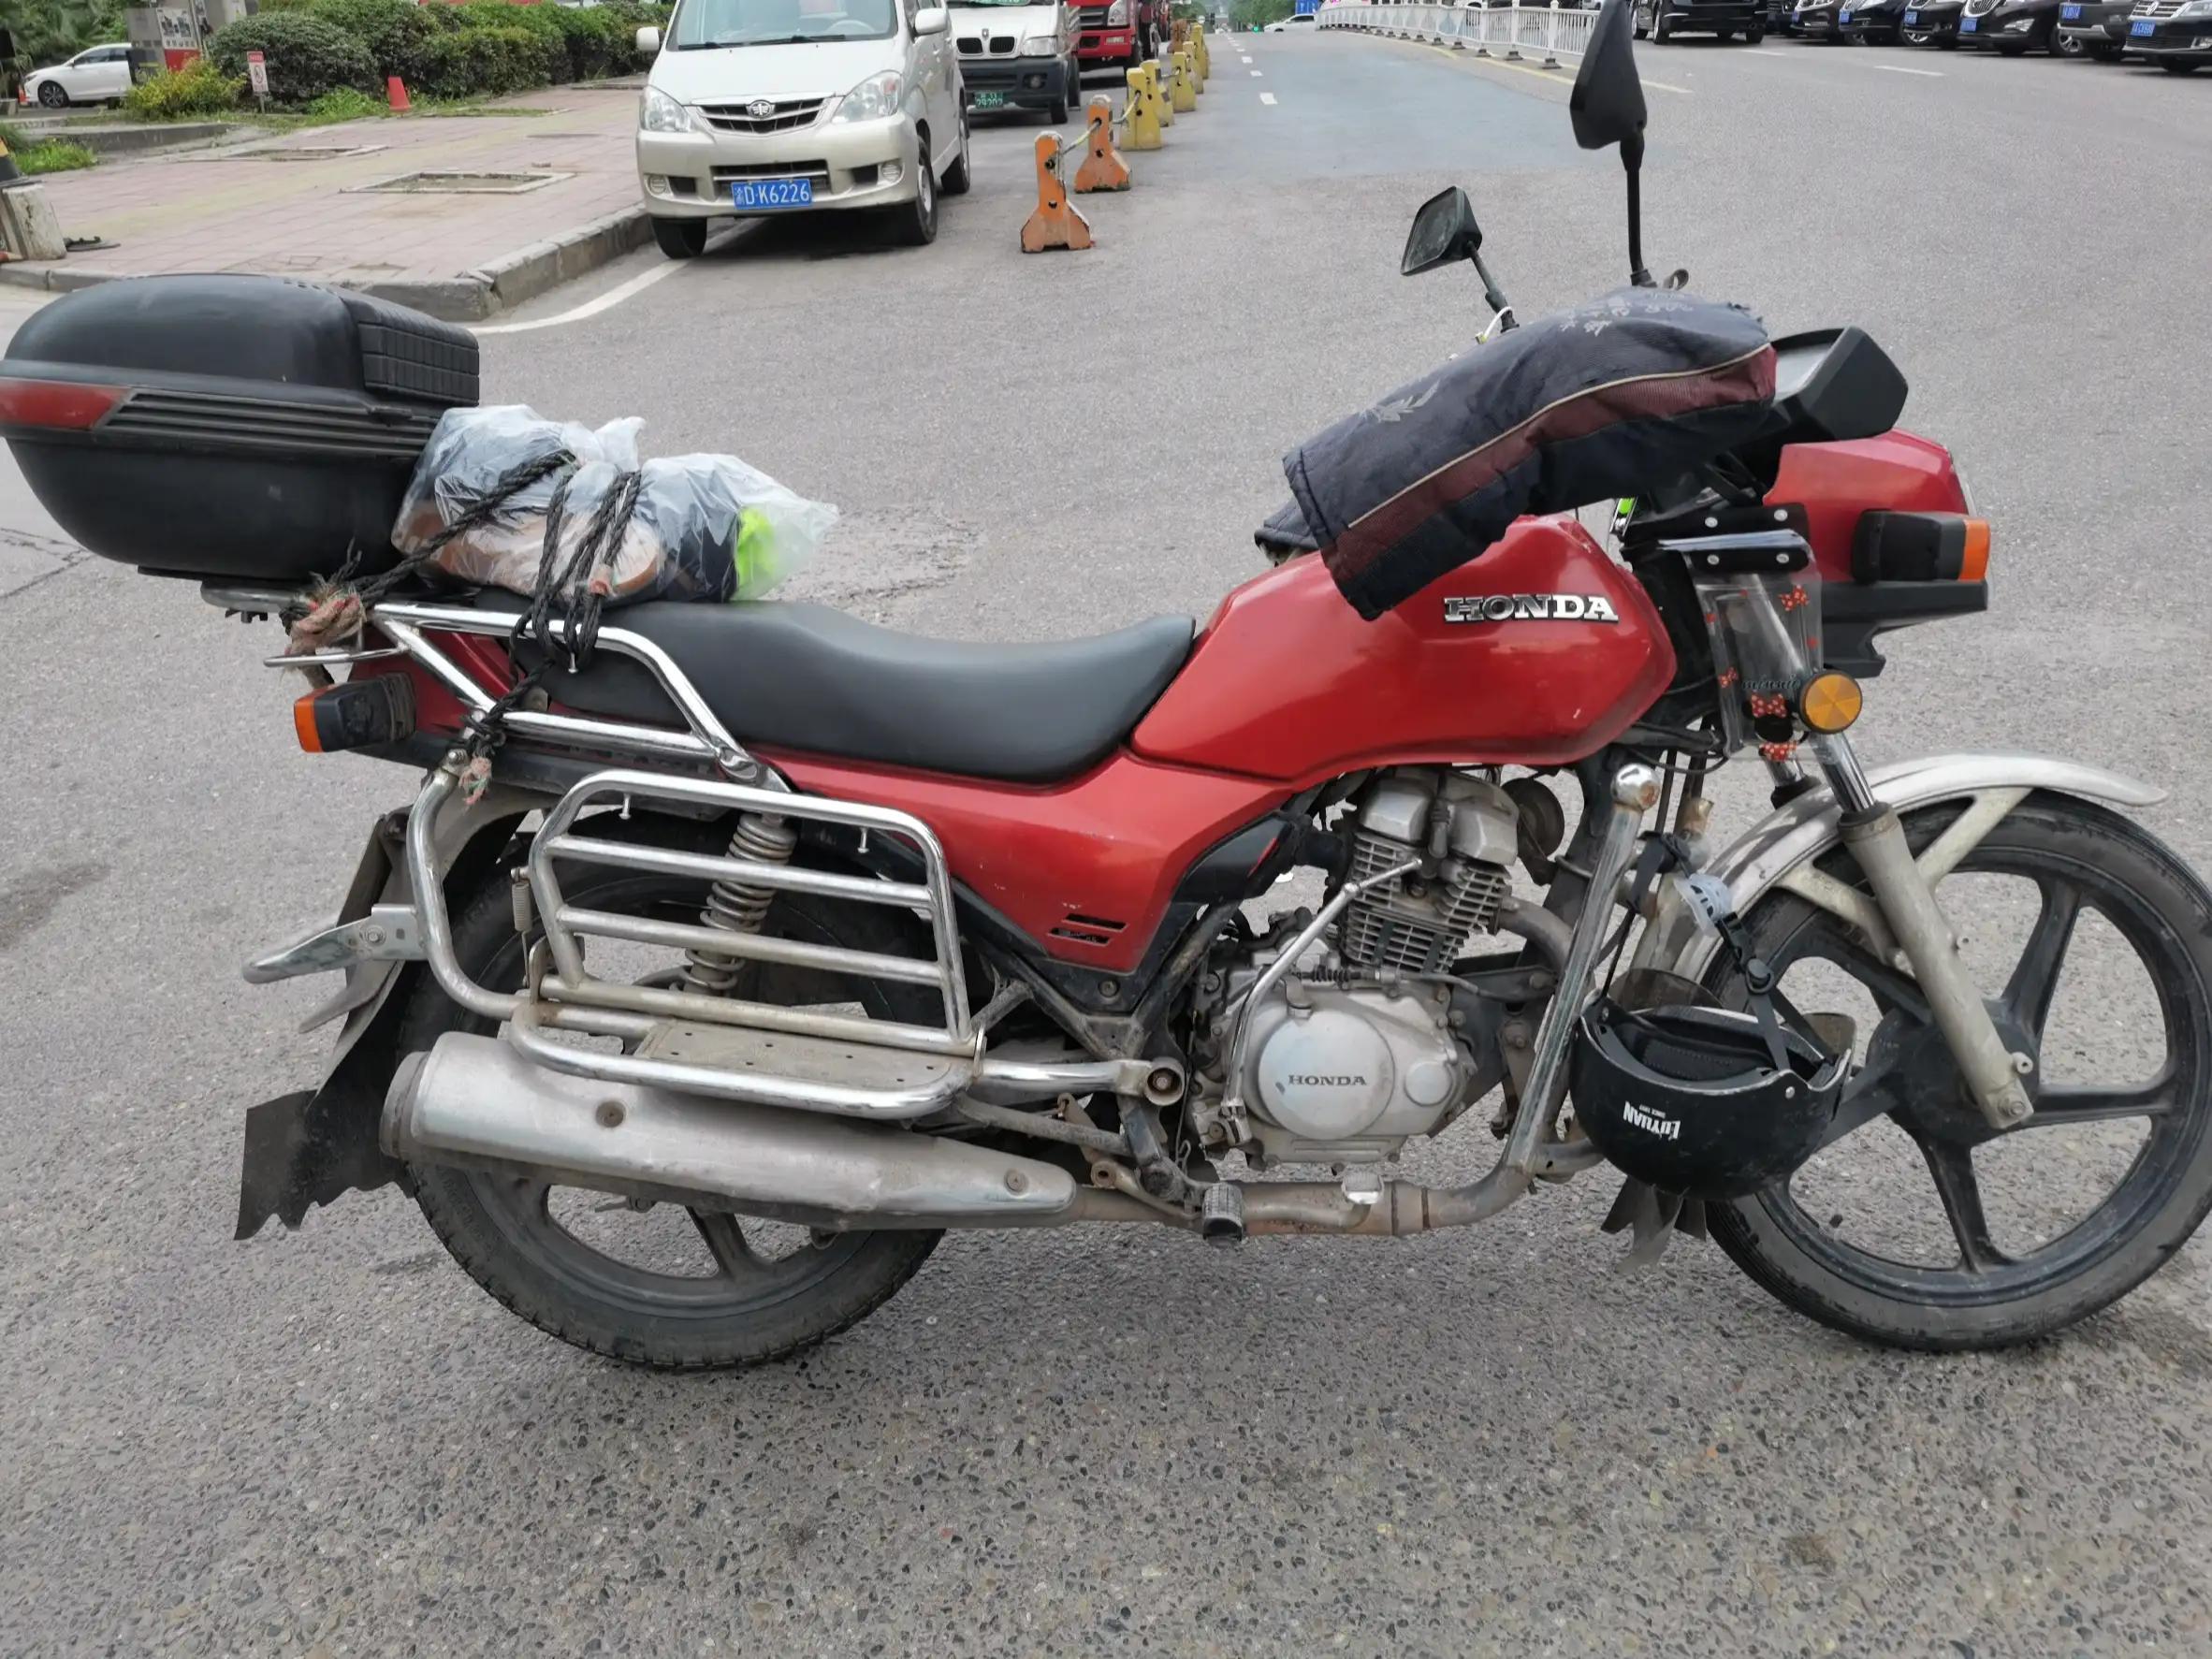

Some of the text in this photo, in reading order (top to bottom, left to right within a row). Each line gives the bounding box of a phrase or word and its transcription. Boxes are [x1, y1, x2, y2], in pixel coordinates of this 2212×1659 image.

[1445, 593, 1619, 622] HONDA
[1288, 1075, 1367, 1086] HONDA
[1623, 1100, 1681, 1141] LUYUAN
